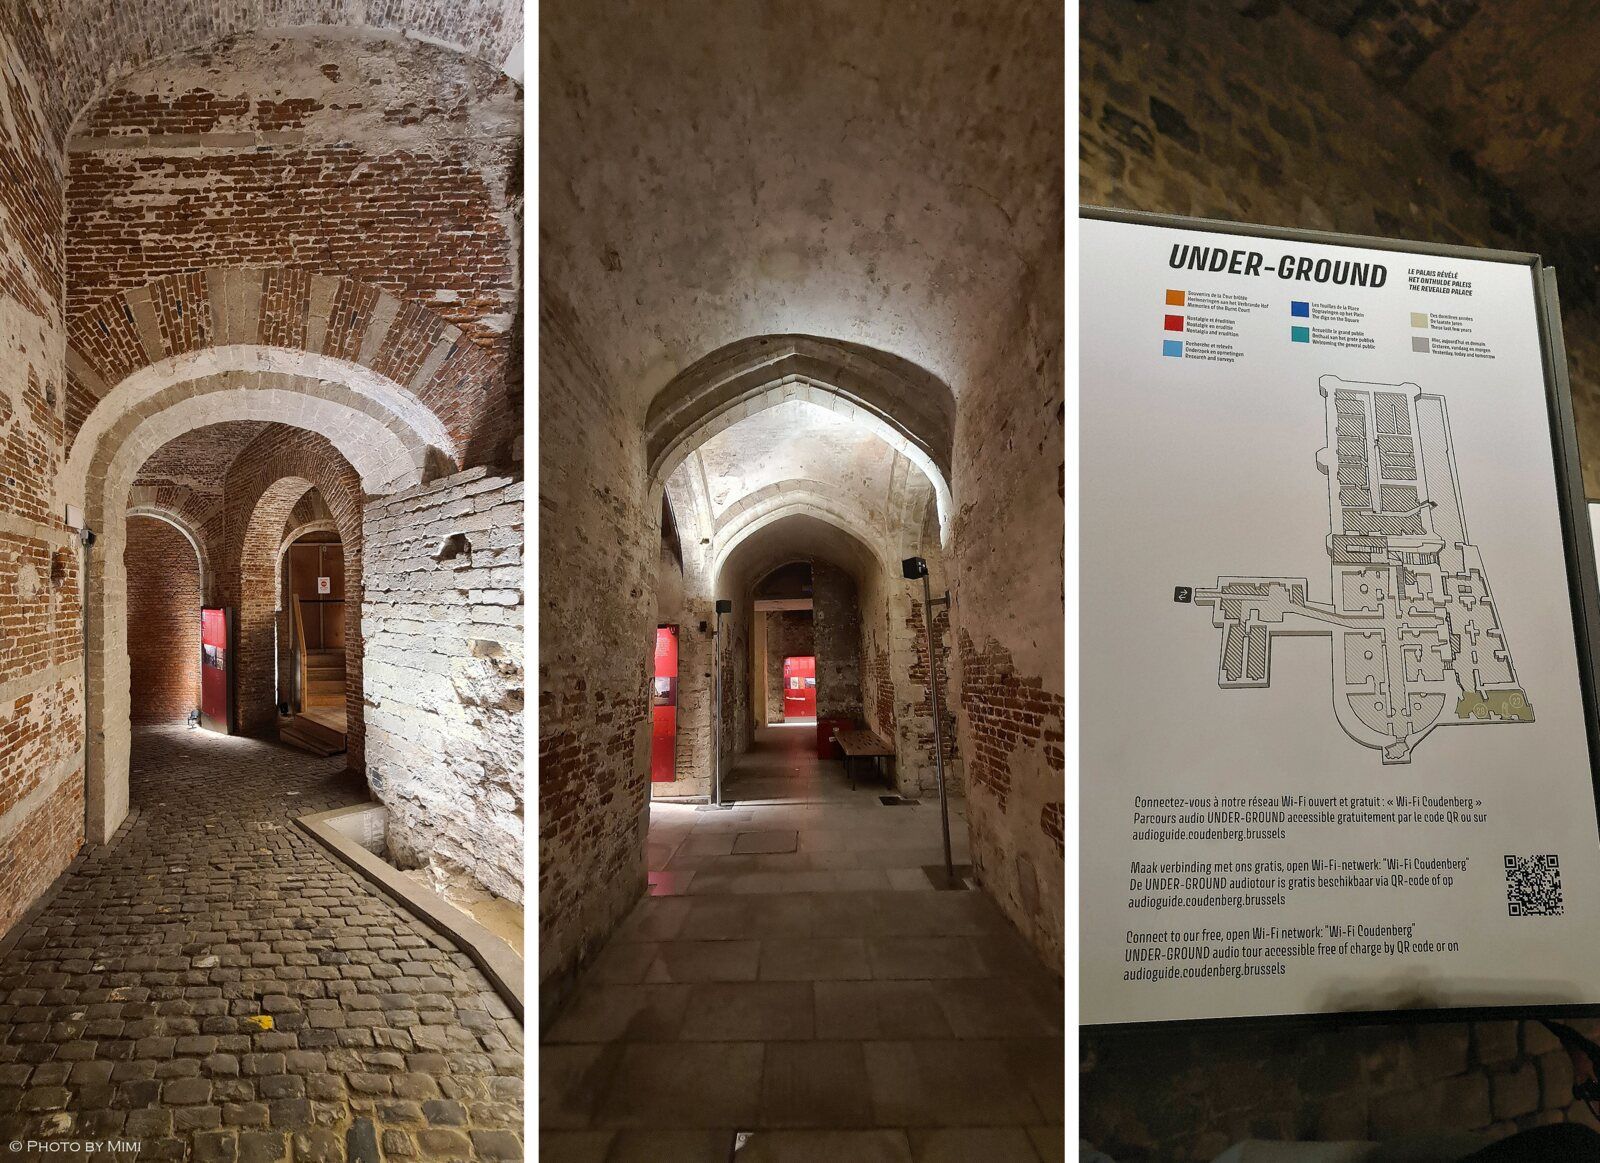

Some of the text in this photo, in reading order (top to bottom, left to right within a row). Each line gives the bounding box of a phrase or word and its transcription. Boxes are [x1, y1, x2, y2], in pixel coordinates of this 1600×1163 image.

[1168, 244, 1388, 288] UNDER-GROUND
[1416, 269, 1436, 277] PALAIS
[1437, 271, 1458, 279] RÉVÉLÉ
[1421, 278, 1451, 286] ONTHULDE
[1421, 286, 1450, 294] REVEALED
[1186, 321, 1209, 329] Nostalgie
[1135, 795, 1473, 809] Connectez-vous à notre réseau Wi-Fi ouvert et gratuit Wi-Fi Coudenberg
[1134, 811, 1487, 824] Parcours audio UNDER-GROUND accessible gratuitement par le code QR ou sur
[1132, 827, 1286, 842] audioguide.coudenberg.brussels
[1130, 861, 1158, 874] Maak
[1160, 861, 1212, 875] verbinding
[1214, 862, 1233, 873] met
[1235, 862, 1252, 872] ons
[1254, 861, 1285, 874] gratis,
[1286, 862, 1309, 873] open
[1312, 858, 1382, 871] Wi-Fi-netwerk:
[1414, 857, 1469, 872] Coudenberg"
[1130, 874, 1453, 891] De UNDER-GROUND audiotour is gratis beschikbaar via QR-code of op
[1128, 894, 1286, 910] audioguide.coudenberg.brussels
[1127, 930, 1168, 943] Connect
[1171, 931, 1180, 942] to
[1184, 932, 1199, 942] our
[1202, 929, 1224, 943] free,
[1226, 928, 1250, 942] open
[1252, 927, 1279, 940] Wi-Fi
[1281, 927, 1324, 939] network:
[1357, 922, 1416, 938] Coudenberg"
[1125, 940, 1459, 962] UNDER-GROUND audio tour accessible free of charge by QR code or on
[1123, 962, 1286, 982] audioguide.coudenberg.brussels
